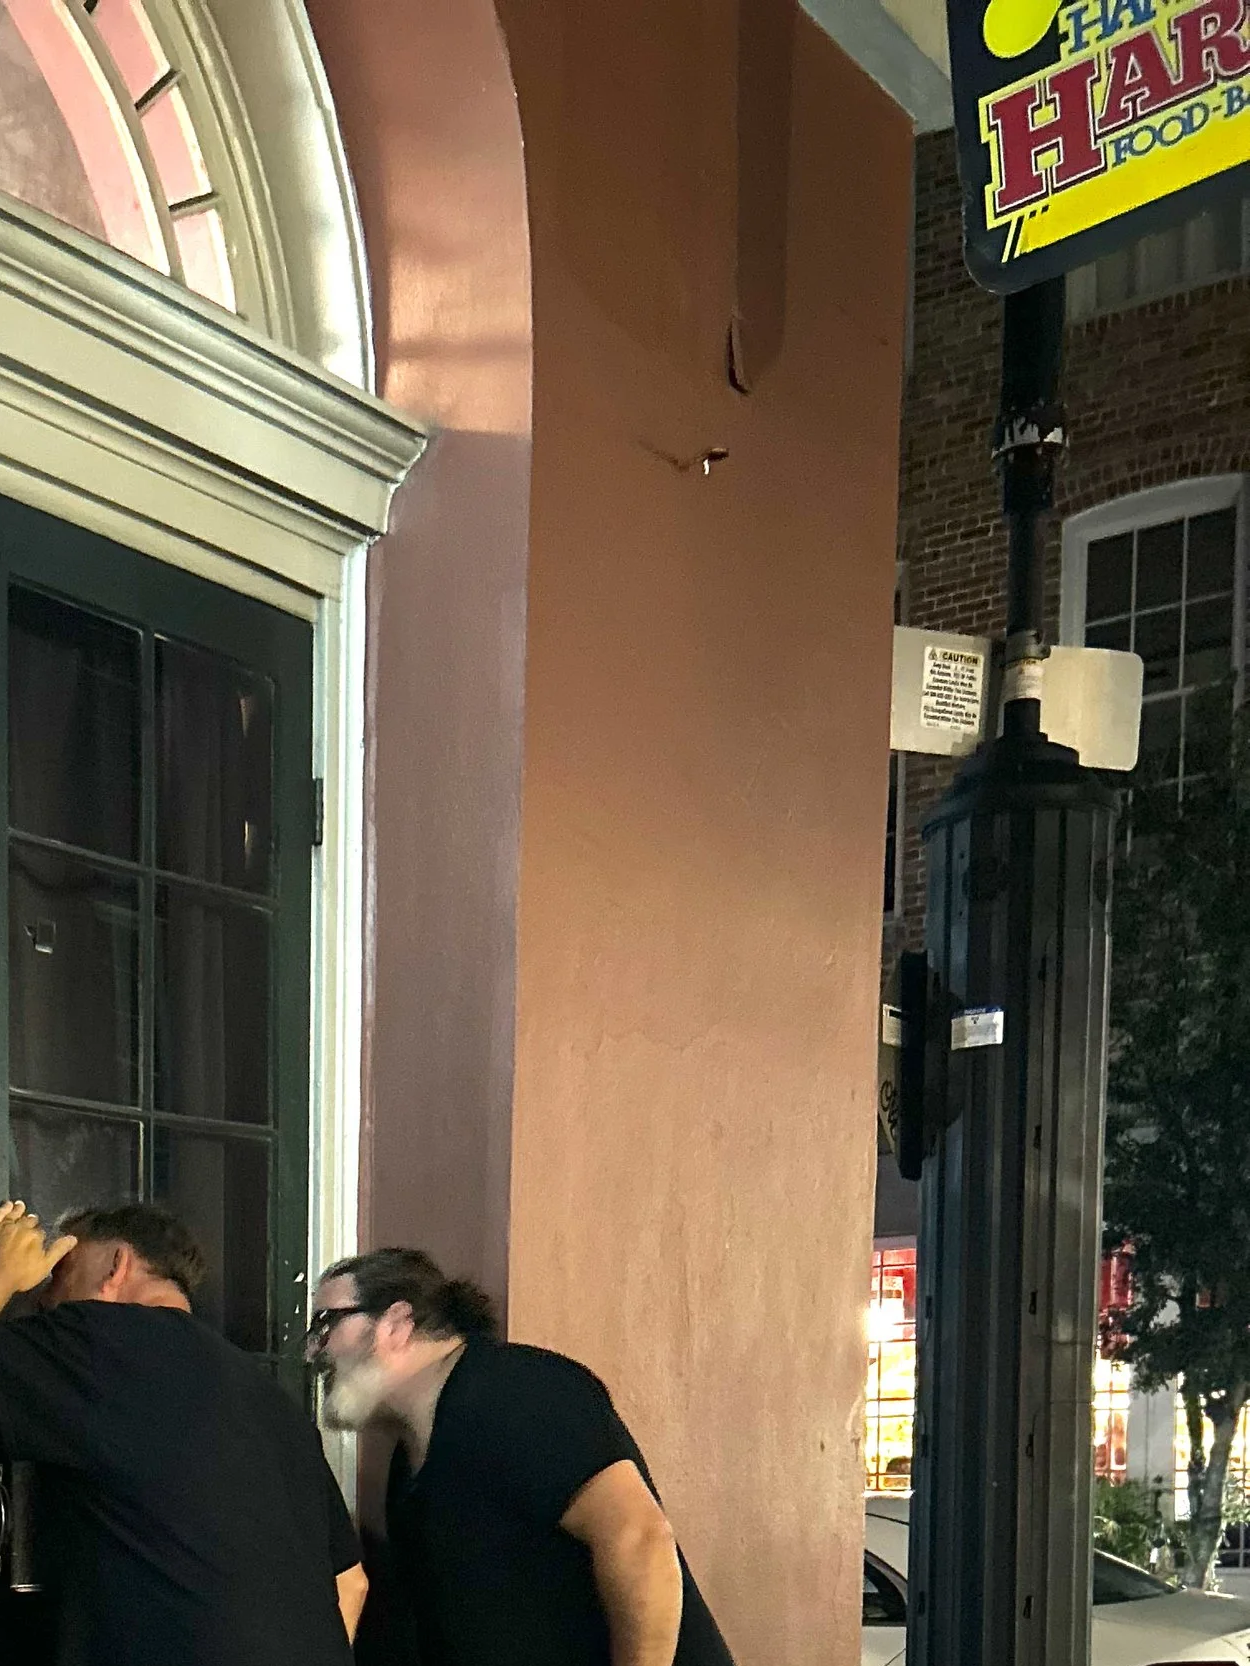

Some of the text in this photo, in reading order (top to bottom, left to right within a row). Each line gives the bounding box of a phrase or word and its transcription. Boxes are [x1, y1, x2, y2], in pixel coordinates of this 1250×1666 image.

[1066, 0, 1180, 52] HA
[1111, 86, 1250, 166] FOOD-B
[942, 651, 978, 665] CAUTION
